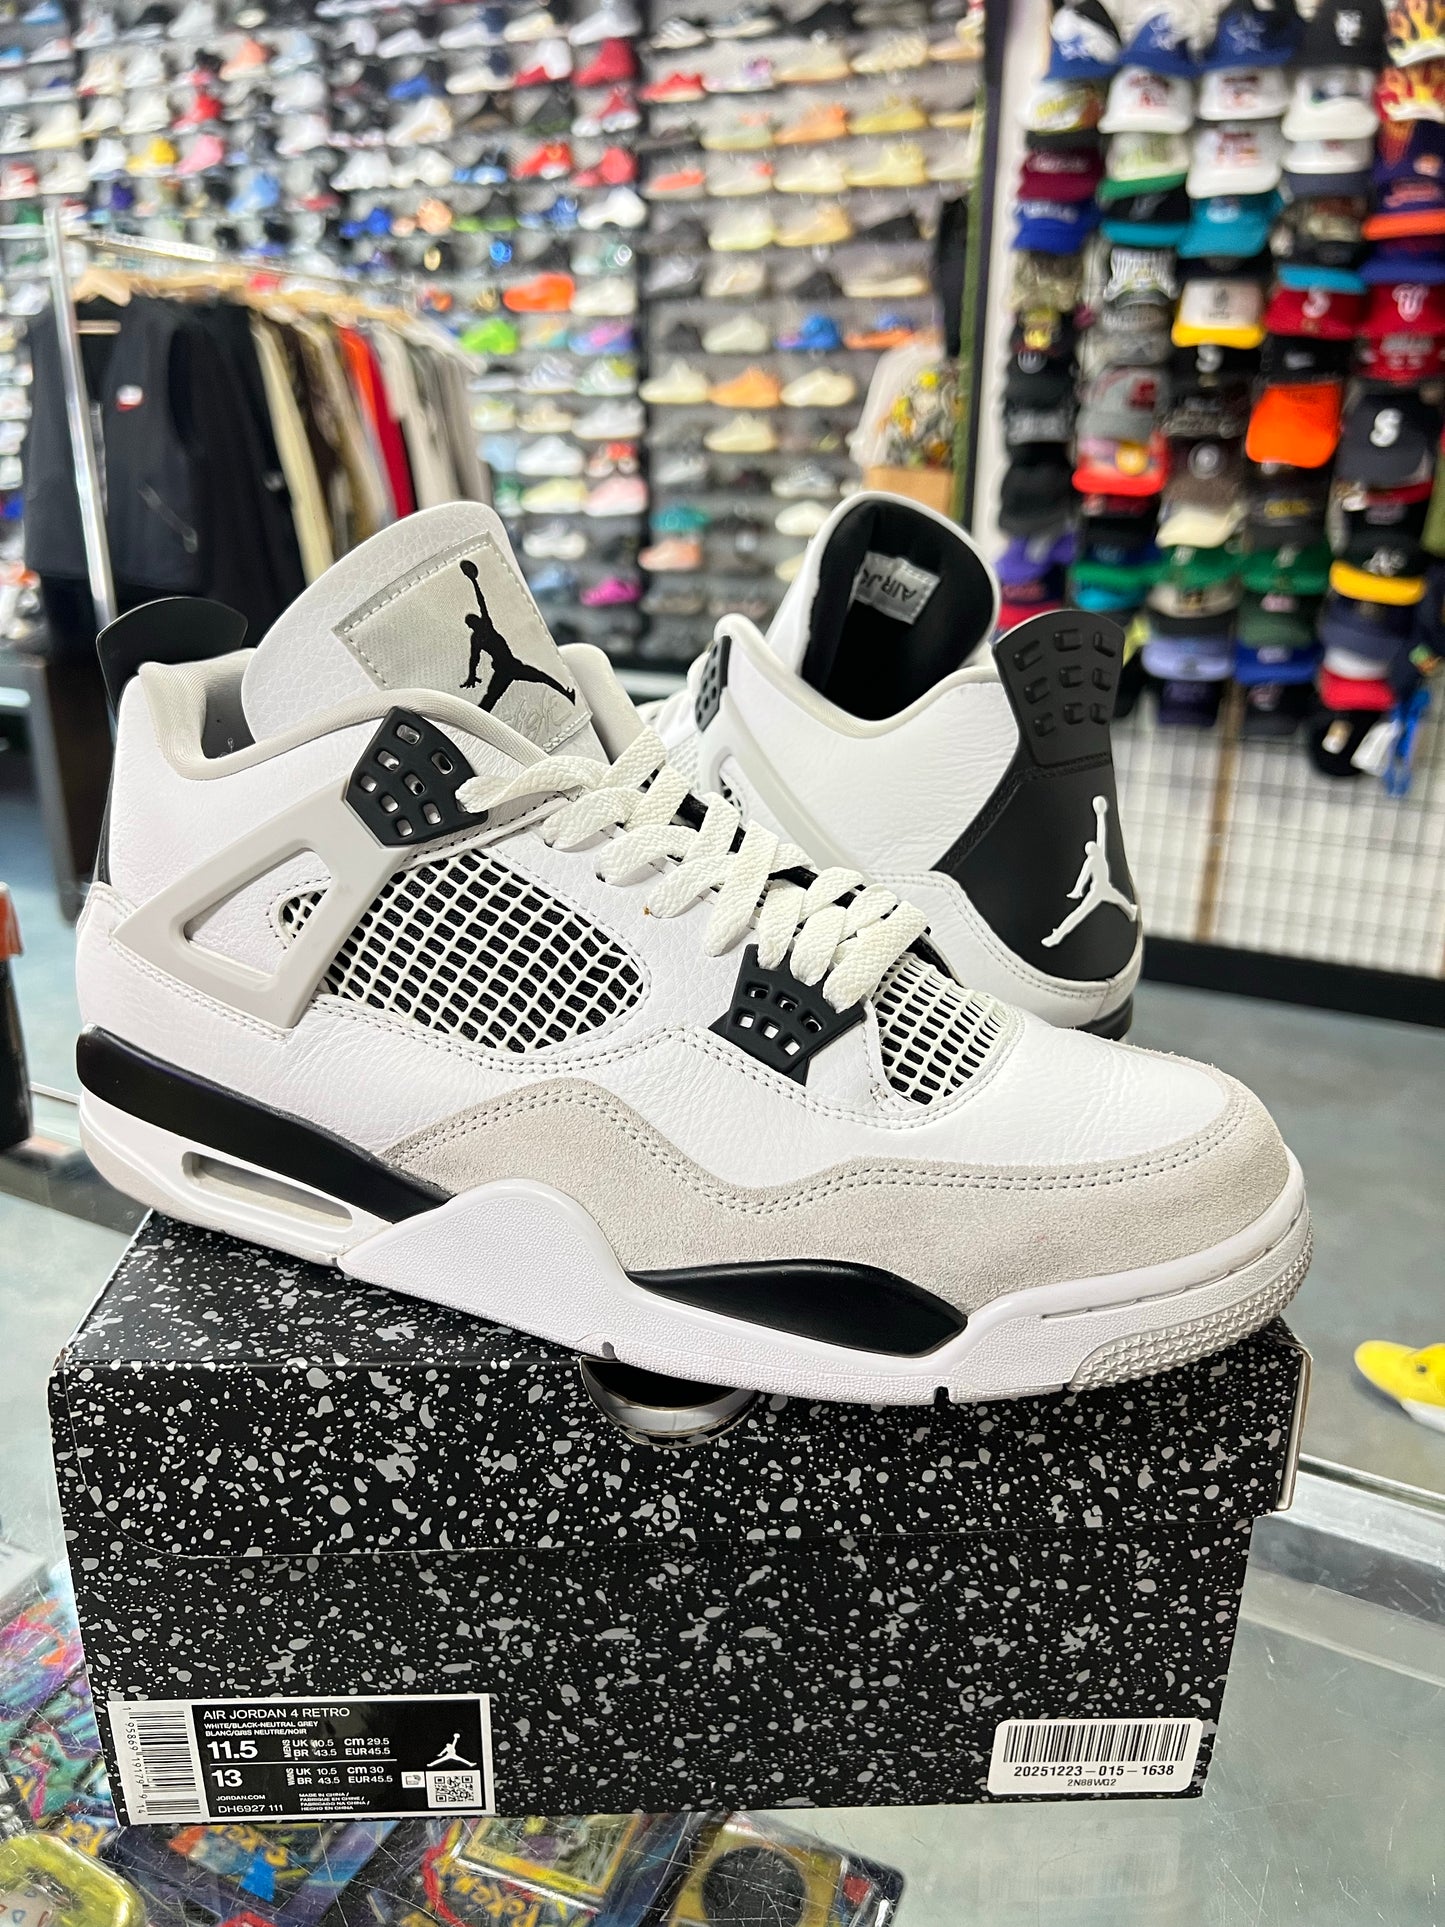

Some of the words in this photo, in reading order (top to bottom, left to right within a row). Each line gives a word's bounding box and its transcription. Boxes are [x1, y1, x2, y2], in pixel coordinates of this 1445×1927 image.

[881, 576, 917, 602] AIR
[203, 1709, 227, 1720] AIR
[229, 1708, 287, 1720] JORDAN
[290, 1708, 299, 1718] 4
[302, 1707, 350, 1718] RETRO
[204, 1721, 296, 1730] WHITE/BLACK-NEUTRAL
[125, 1722, 139, 1751] 95869
[205, 1729, 253, 1737] BLANC/GRIS
[254, 1728, 307, 1736] NEUTRE/NOIR
[292, 1739, 308, 1748] UK
[343, 1738, 365, 1746] cm
[366, 1737, 390, 1746] 29.5
[206, 1740, 258, 1759] 11.5
[293, 1749, 309, 1757] BR
[315, 1749, 337, 1757] 43.5
[131, 1757, 145, 1785] 19179
[296, 1768, 311, 1776] UK
[316, 1768, 337, 1776] 10.5
[347, 1766, 368, 1774] cm
[369, 1766, 384, 1774] 30
[211, 1769, 243, 1787] 13
[297, 1777, 313, 1785] BR
[317, 1776, 340, 1785] 43.5
[218, 1804, 265, 1813] DH6927
[269, 1804, 283, 1812] 111
